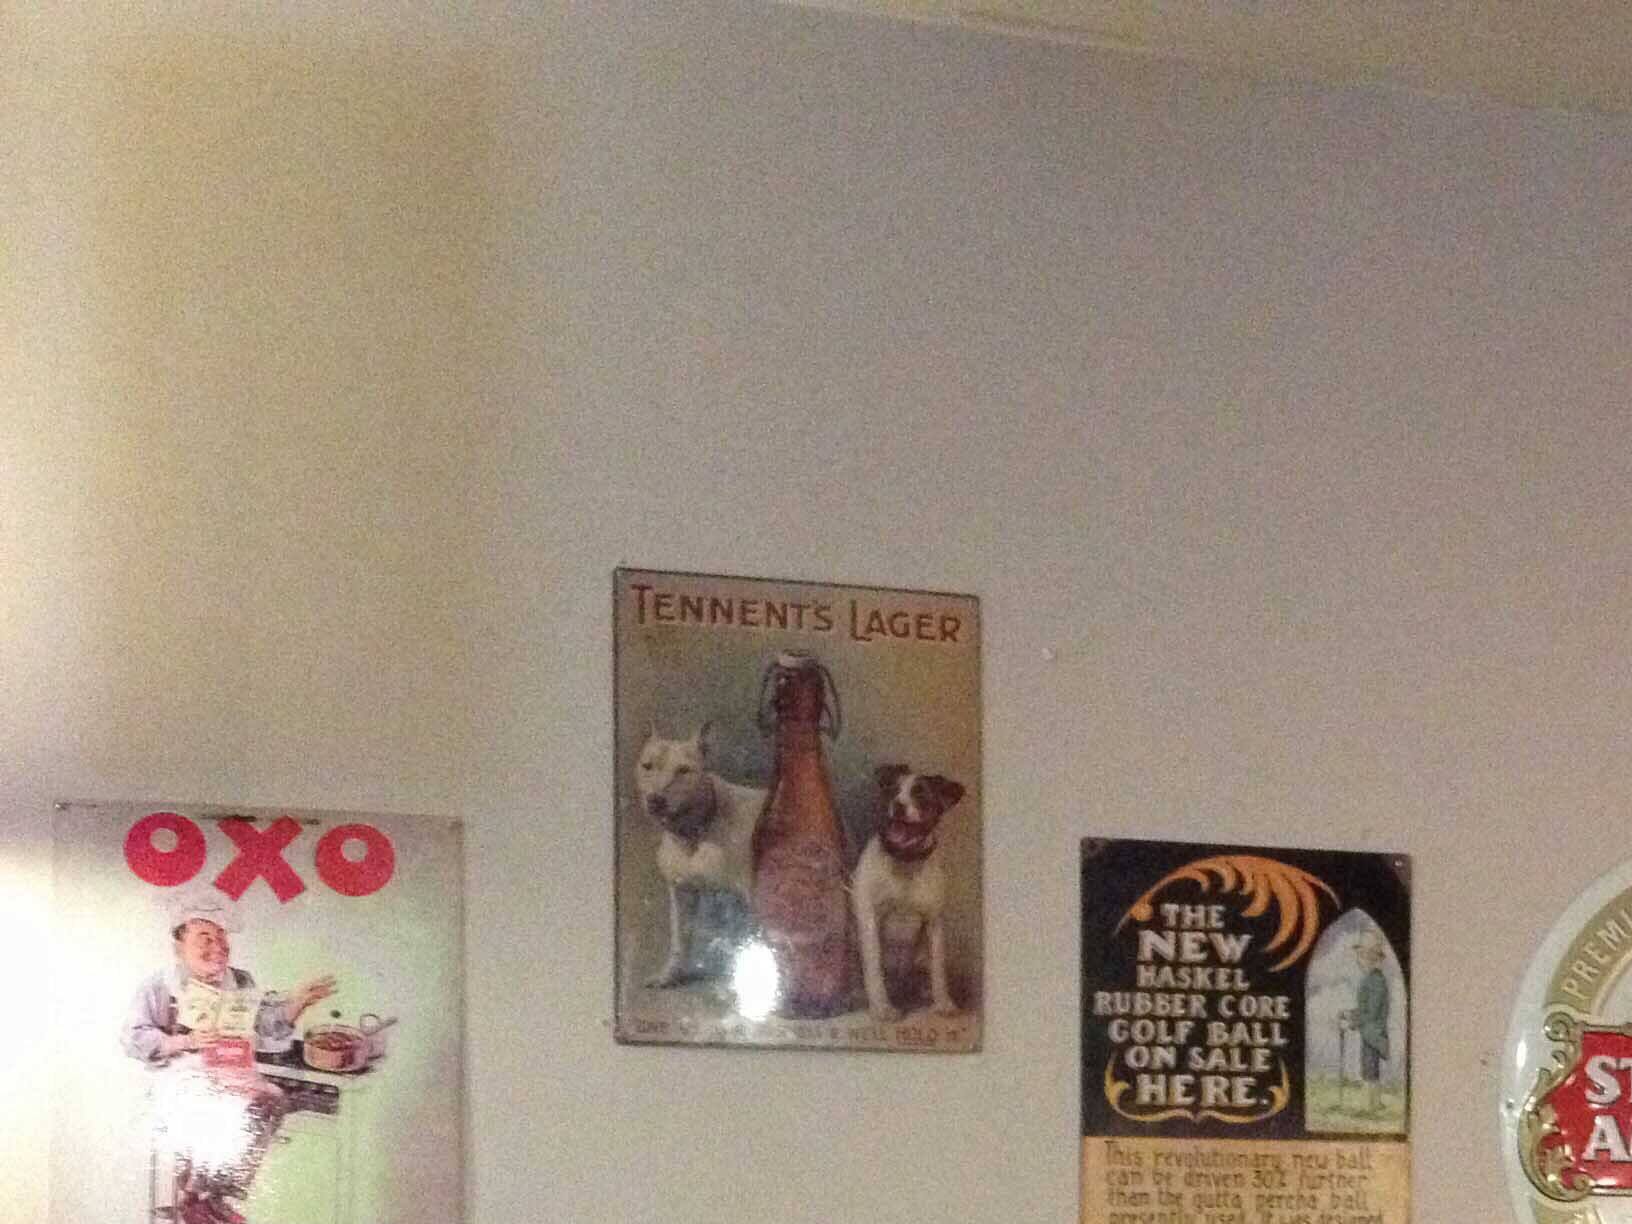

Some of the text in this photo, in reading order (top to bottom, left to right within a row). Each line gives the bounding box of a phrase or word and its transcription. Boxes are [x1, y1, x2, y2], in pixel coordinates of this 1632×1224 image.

[632, 584, 963, 643] TENNENT'S LAGER
[123, 811, 395, 904] OXO
[1160, 904, 1226, 929] THE
[1138, 930, 1253, 963] NEW
[1136, 964, 1251, 992] HASKEL
[1093, 990, 1292, 1019] RUBBER CORE
[1107, 1019, 1289, 1046] GOLF BALL
[1124, 1045, 1272, 1073] ON SALE
[1135, 1074, 1270, 1107] HERE.
